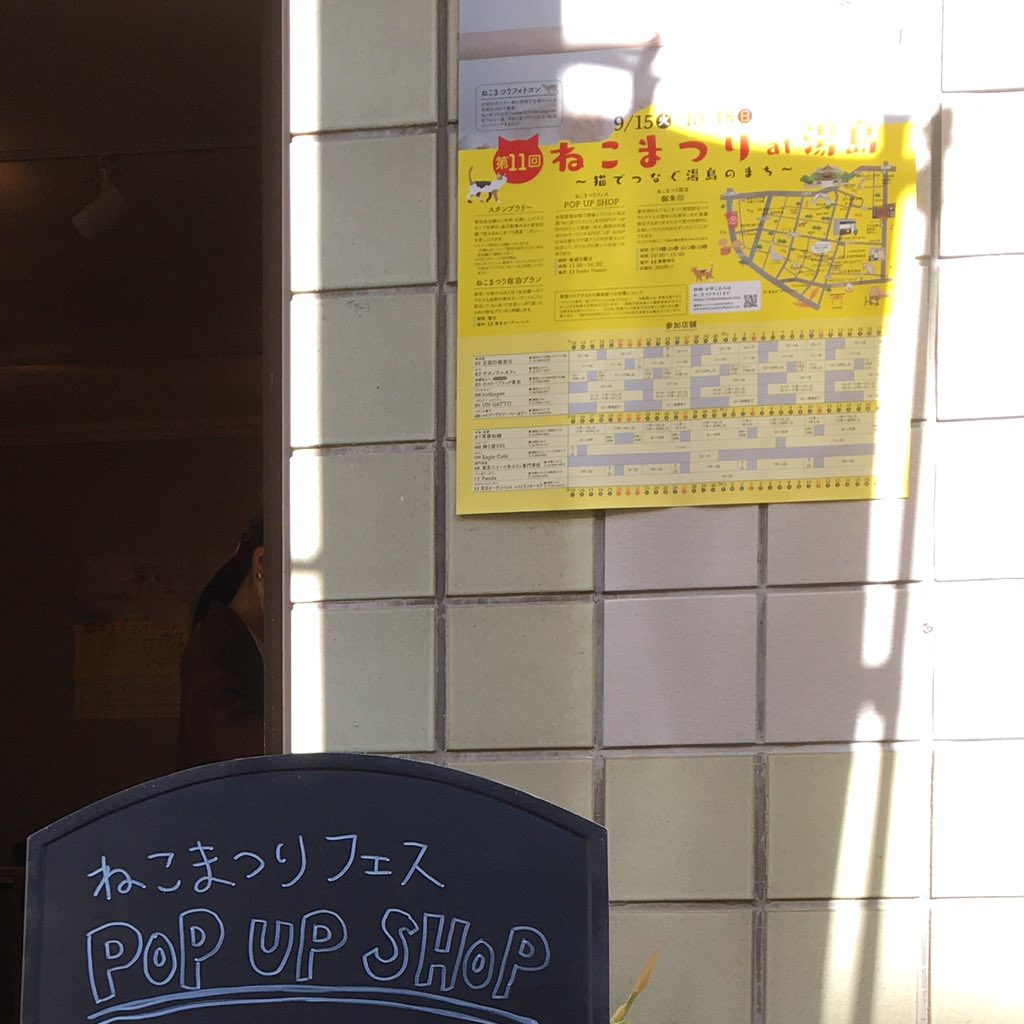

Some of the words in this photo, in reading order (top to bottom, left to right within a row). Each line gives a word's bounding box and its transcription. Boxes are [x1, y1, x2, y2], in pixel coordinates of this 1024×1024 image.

[495, 153, 542, 172] 第11回
[564, 200, 581, 209] POP
[583, 200, 595, 208] UP
[596, 198, 620, 207] SHOP
[86, 833, 445, 900] ねこまつりフェス
[86, 908, 226, 1004] POP
[248, 909, 348, 982] UP
[362, 908, 552, 1000] SHOP
